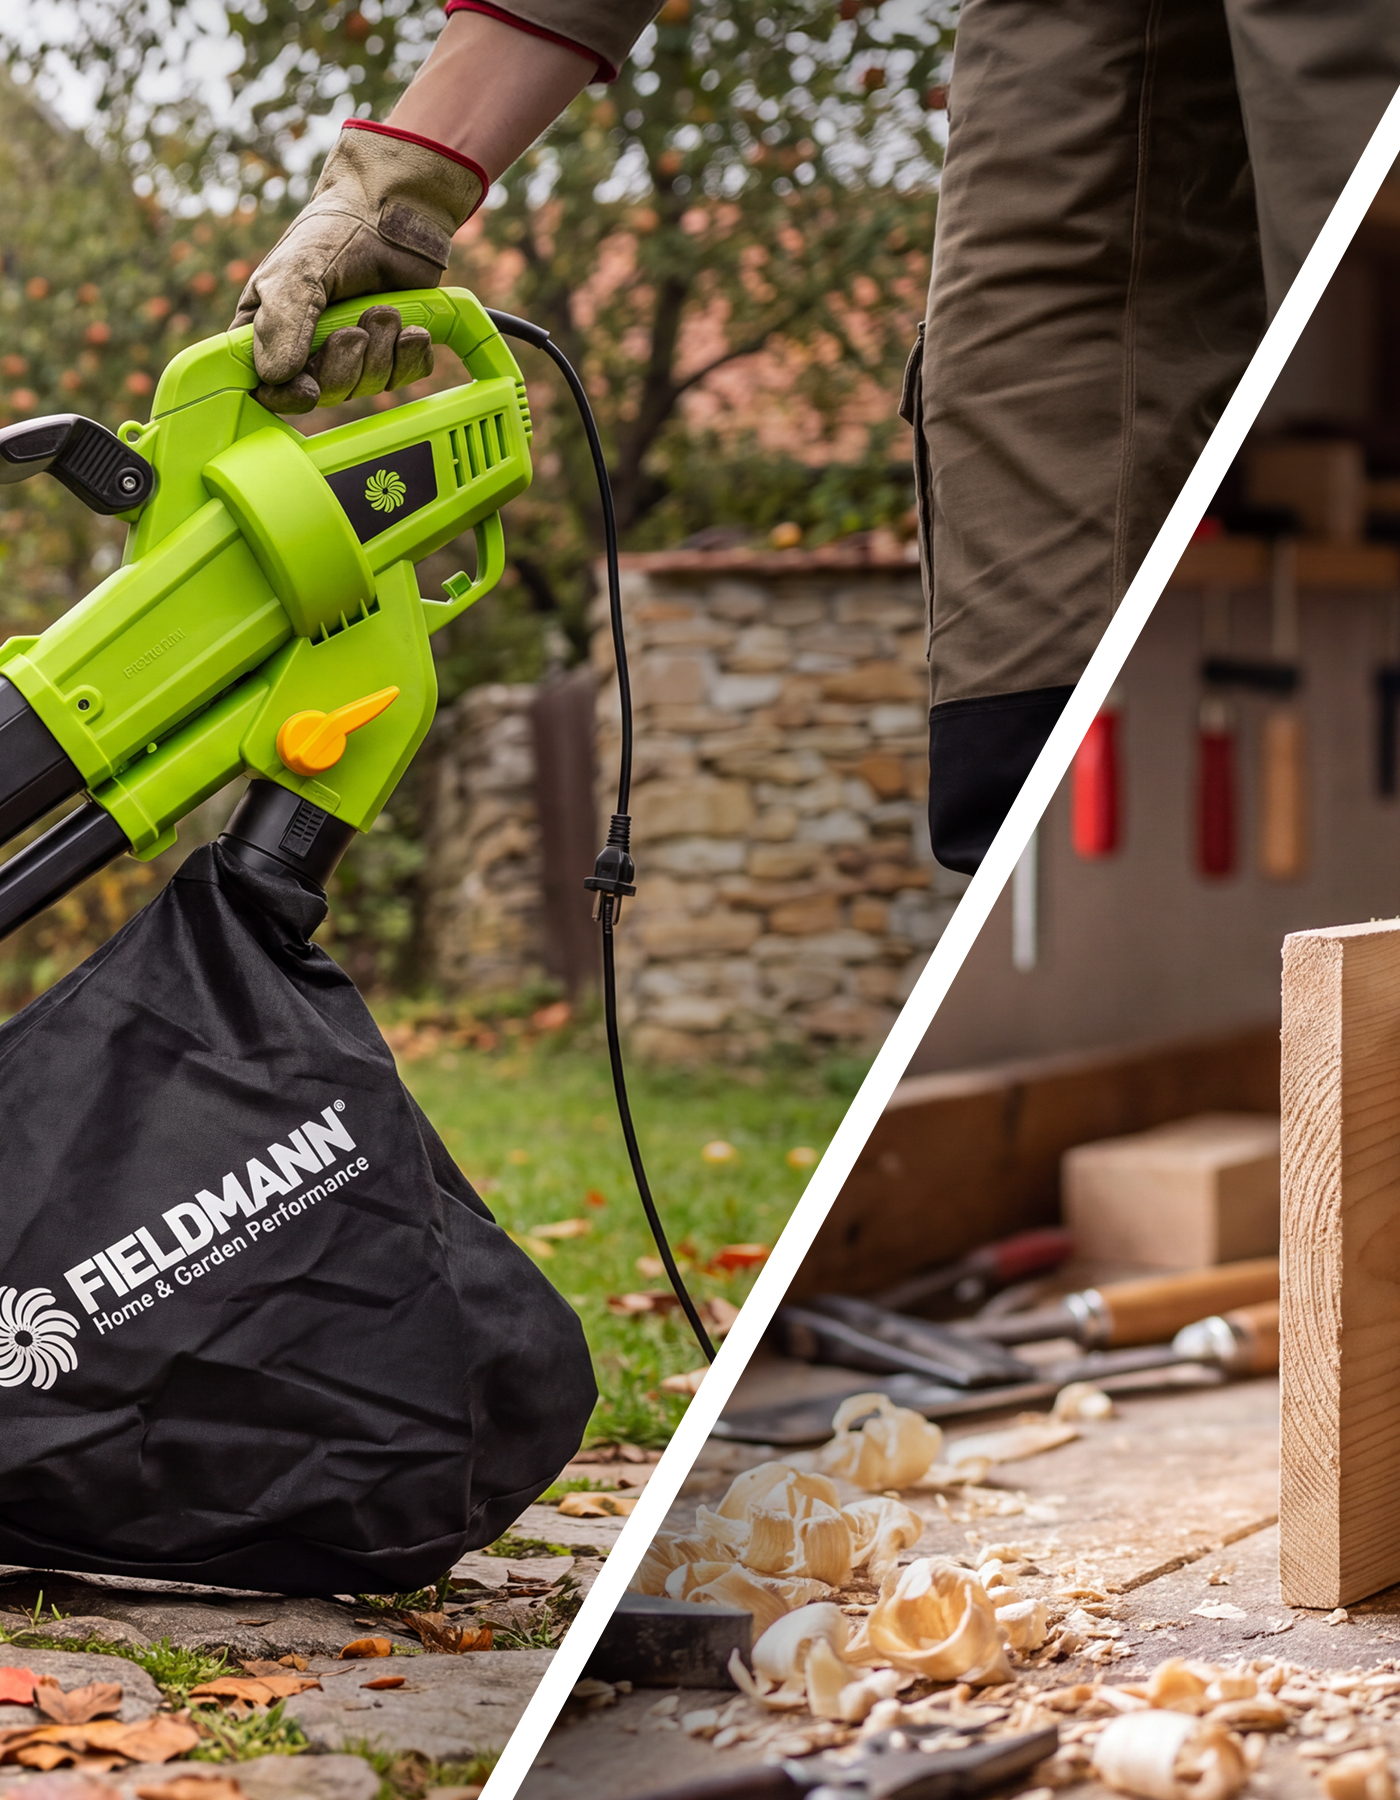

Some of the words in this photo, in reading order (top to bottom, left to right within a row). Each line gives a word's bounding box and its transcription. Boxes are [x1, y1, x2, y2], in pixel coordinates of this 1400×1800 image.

[93, 1293, 155, 1335] Home
[155, 1279, 175, 1299] &
[175, 1237, 248, 1286] Garden
[245, 1156, 370, 1242] Performance
